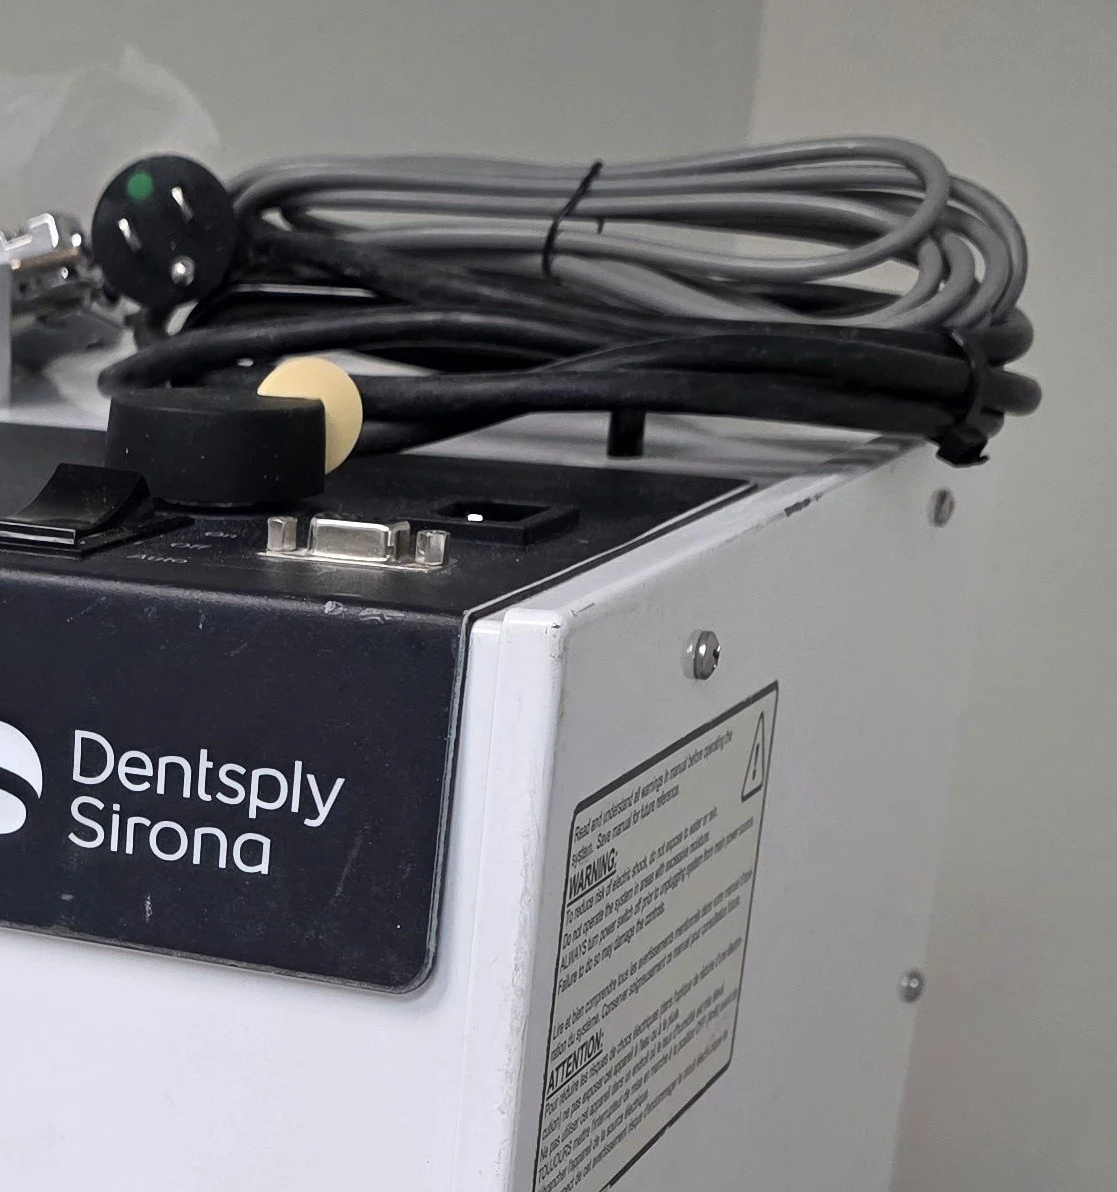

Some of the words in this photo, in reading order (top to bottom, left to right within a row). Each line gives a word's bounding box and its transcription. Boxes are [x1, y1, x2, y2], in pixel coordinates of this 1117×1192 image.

[73, 730, 345, 827] Dentsply
[574, 819, 591, 842] Read
[603, 793, 633, 824] understand
[641, 775, 663, 798] warnings
[670, 760, 687, 779] manual
[688, 750, 703, 768] before
[68, 796, 271, 875] Sirona
[572, 843, 593, 869] system.
[596, 830, 611, 849] Save
[612, 813, 632, 839] manual
[641, 800, 655, 819] future
[569, 848, 617, 899] WARNING:
[575, 896, 594, 918] reduce
[595, 886, 605, 905] risk
[612, 869, 631, 892] electric
[666, 832, 683, 853] expose
[583, 910, 604, 935] operate
[614, 888, 633, 912] system
[640, 872, 654, 892] areas
[558, 971, 577, 995] Failure
[614, 925, 635, 951] damage
[560, 939, 587, 972] ALWAYS
[588, 933, 599, 951] turn
[599, 920, 616, 945] power
[617, 905, 633, 929] switch
[641, 892, 654, 913] prior
[553, 1023, 564, 1041] Lire
[572, 1006, 584, 1025] bien
[585, 979, 617, 1013] comprendre
[617, 969, 629, 987] tous
[602, 989, 628, 1019] Conserver
[544, 1097, 559, 1119] Pour
[589, 1054, 608, 1078] risques
[547, 1030, 603, 1093] ATTENTION:
[582, 1076, 604, 1104] exposer
[539, 1140, 572, 1183] TOUJOURS
